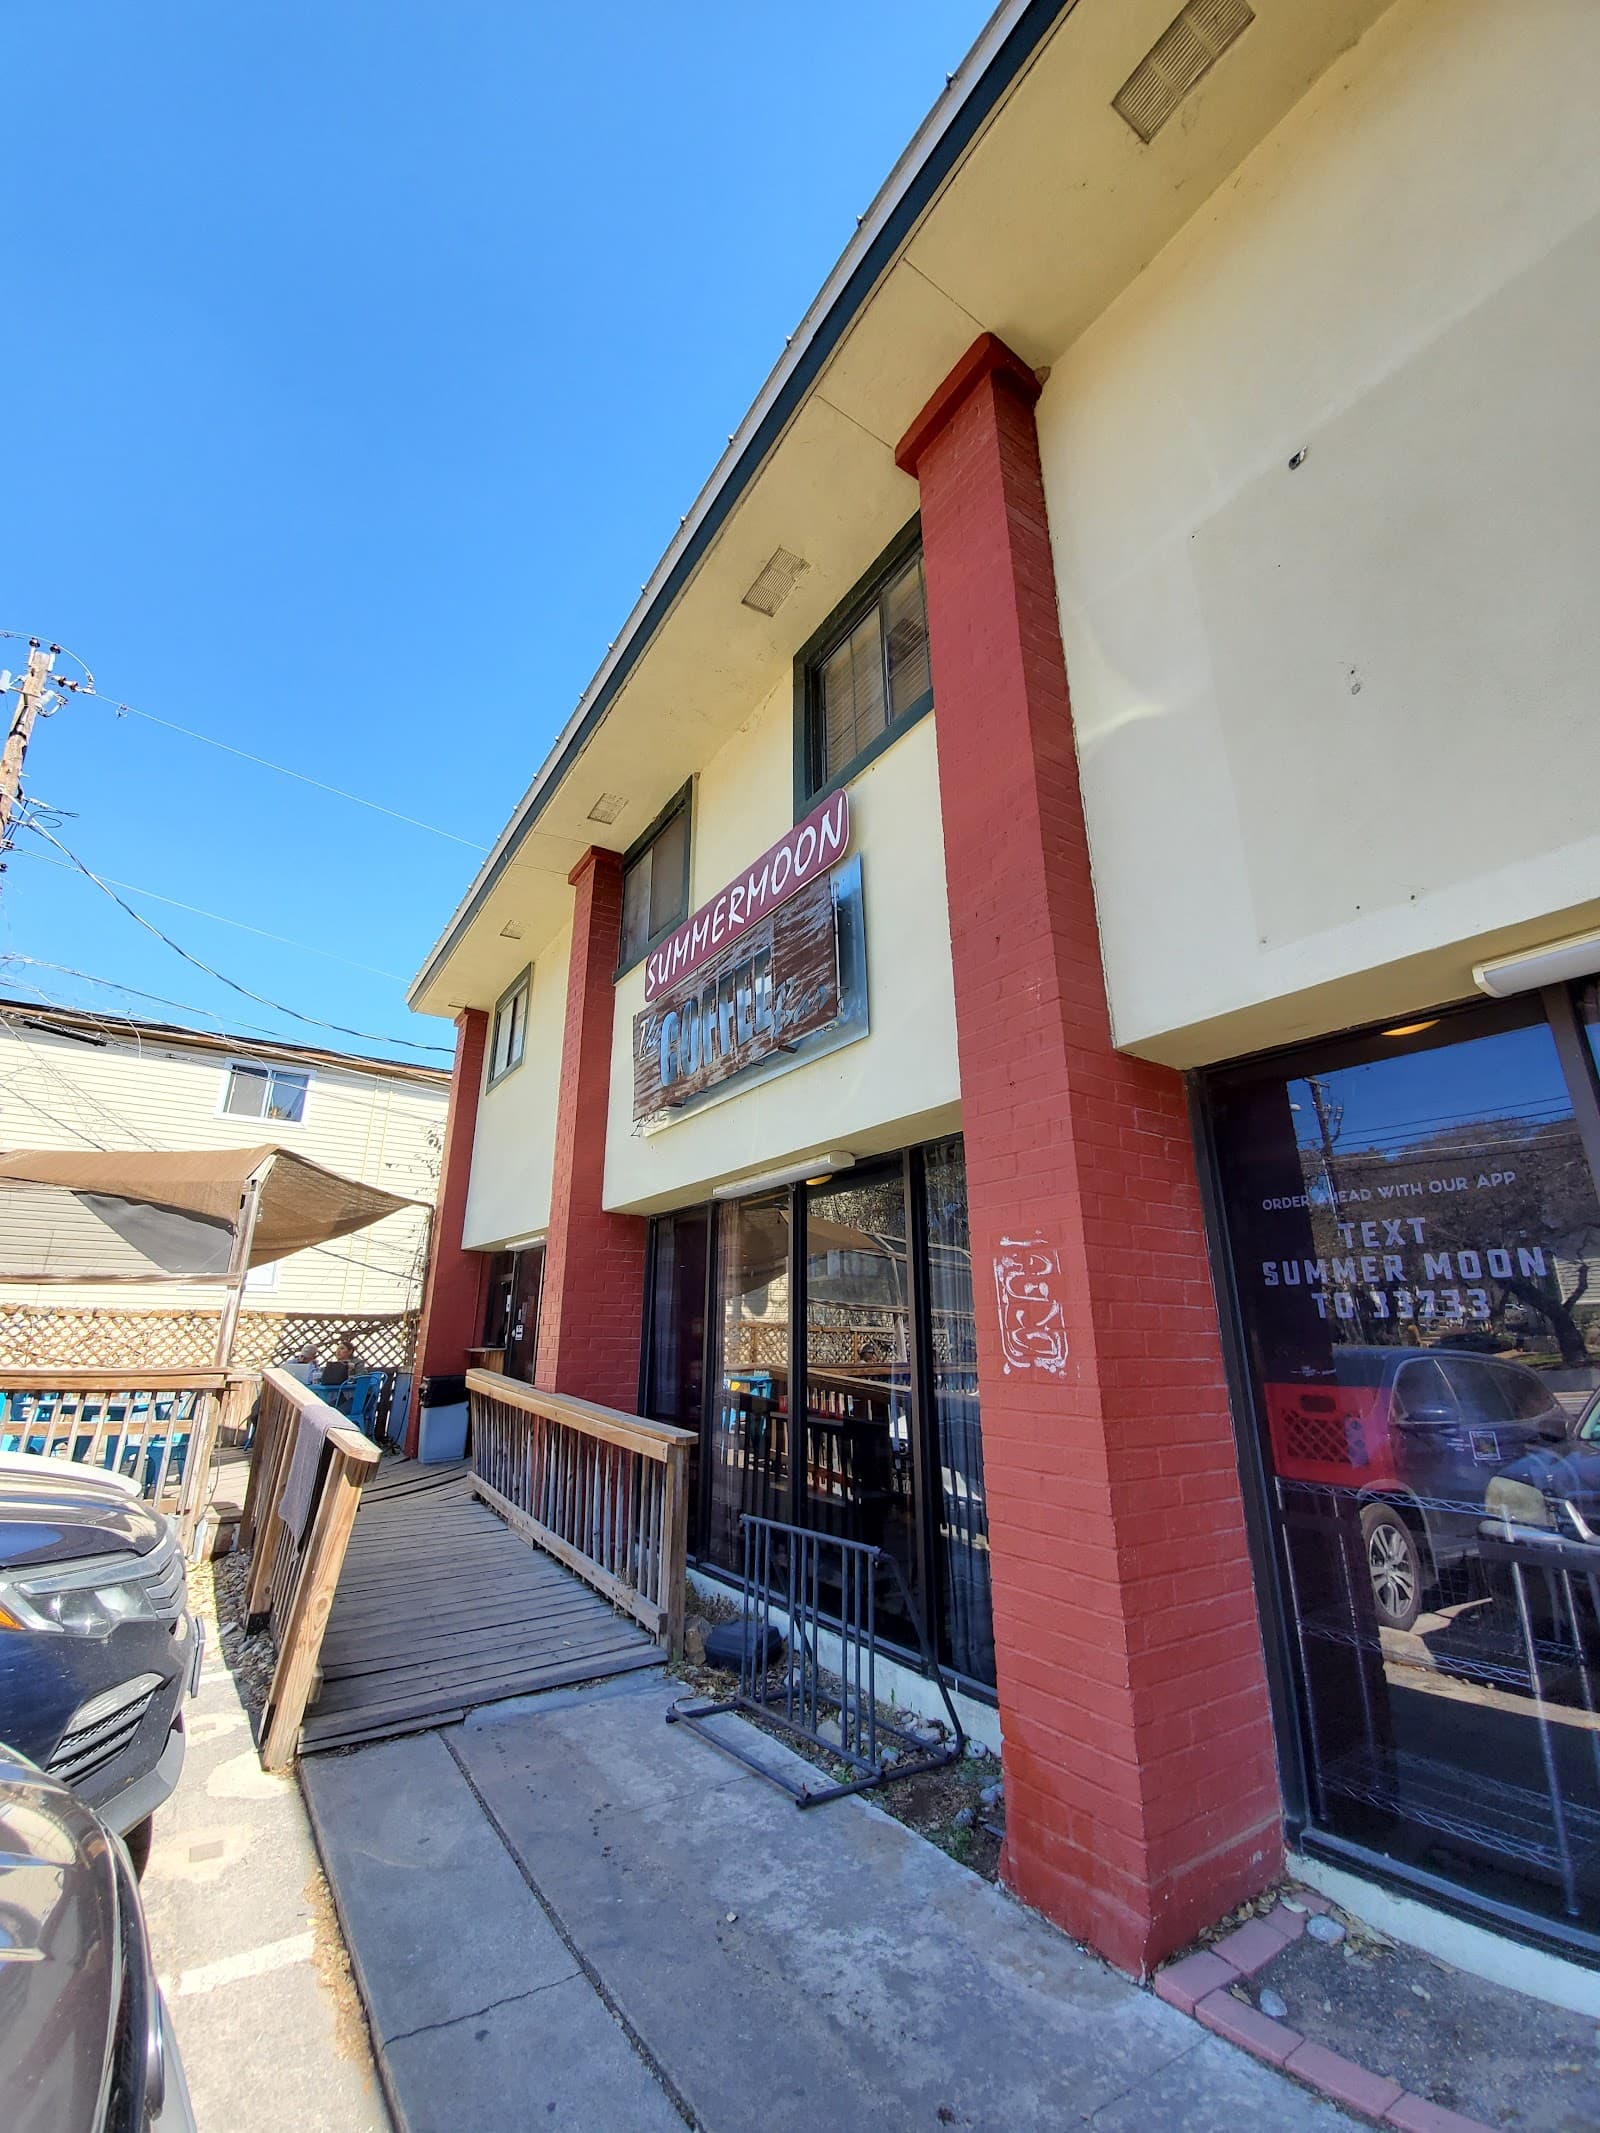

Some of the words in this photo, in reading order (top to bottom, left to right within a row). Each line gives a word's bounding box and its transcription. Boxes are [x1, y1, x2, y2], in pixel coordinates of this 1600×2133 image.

[646, 795, 843, 997] SUMMERMOON
[660, 944, 773, 1087] COFFEE
[1262, 1195, 1309, 1211] ORDER
[1317, 1189, 1372, 1205] AHEAD
[1377, 1184, 1424, 1201] WITH
[1431, 1177, 1468, 1194] OUR
[1476, 1171, 1517, 1189] APP
[1337, 1217, 1426, 1248] TEXT
[1262, 1255, 1407, 1286] SUMMER
[1423, 1247, 1547, 1281] MOON
[1311, 1292, 1355, 1319] TO
[1372, 1289, 1491, 1319] 33733
